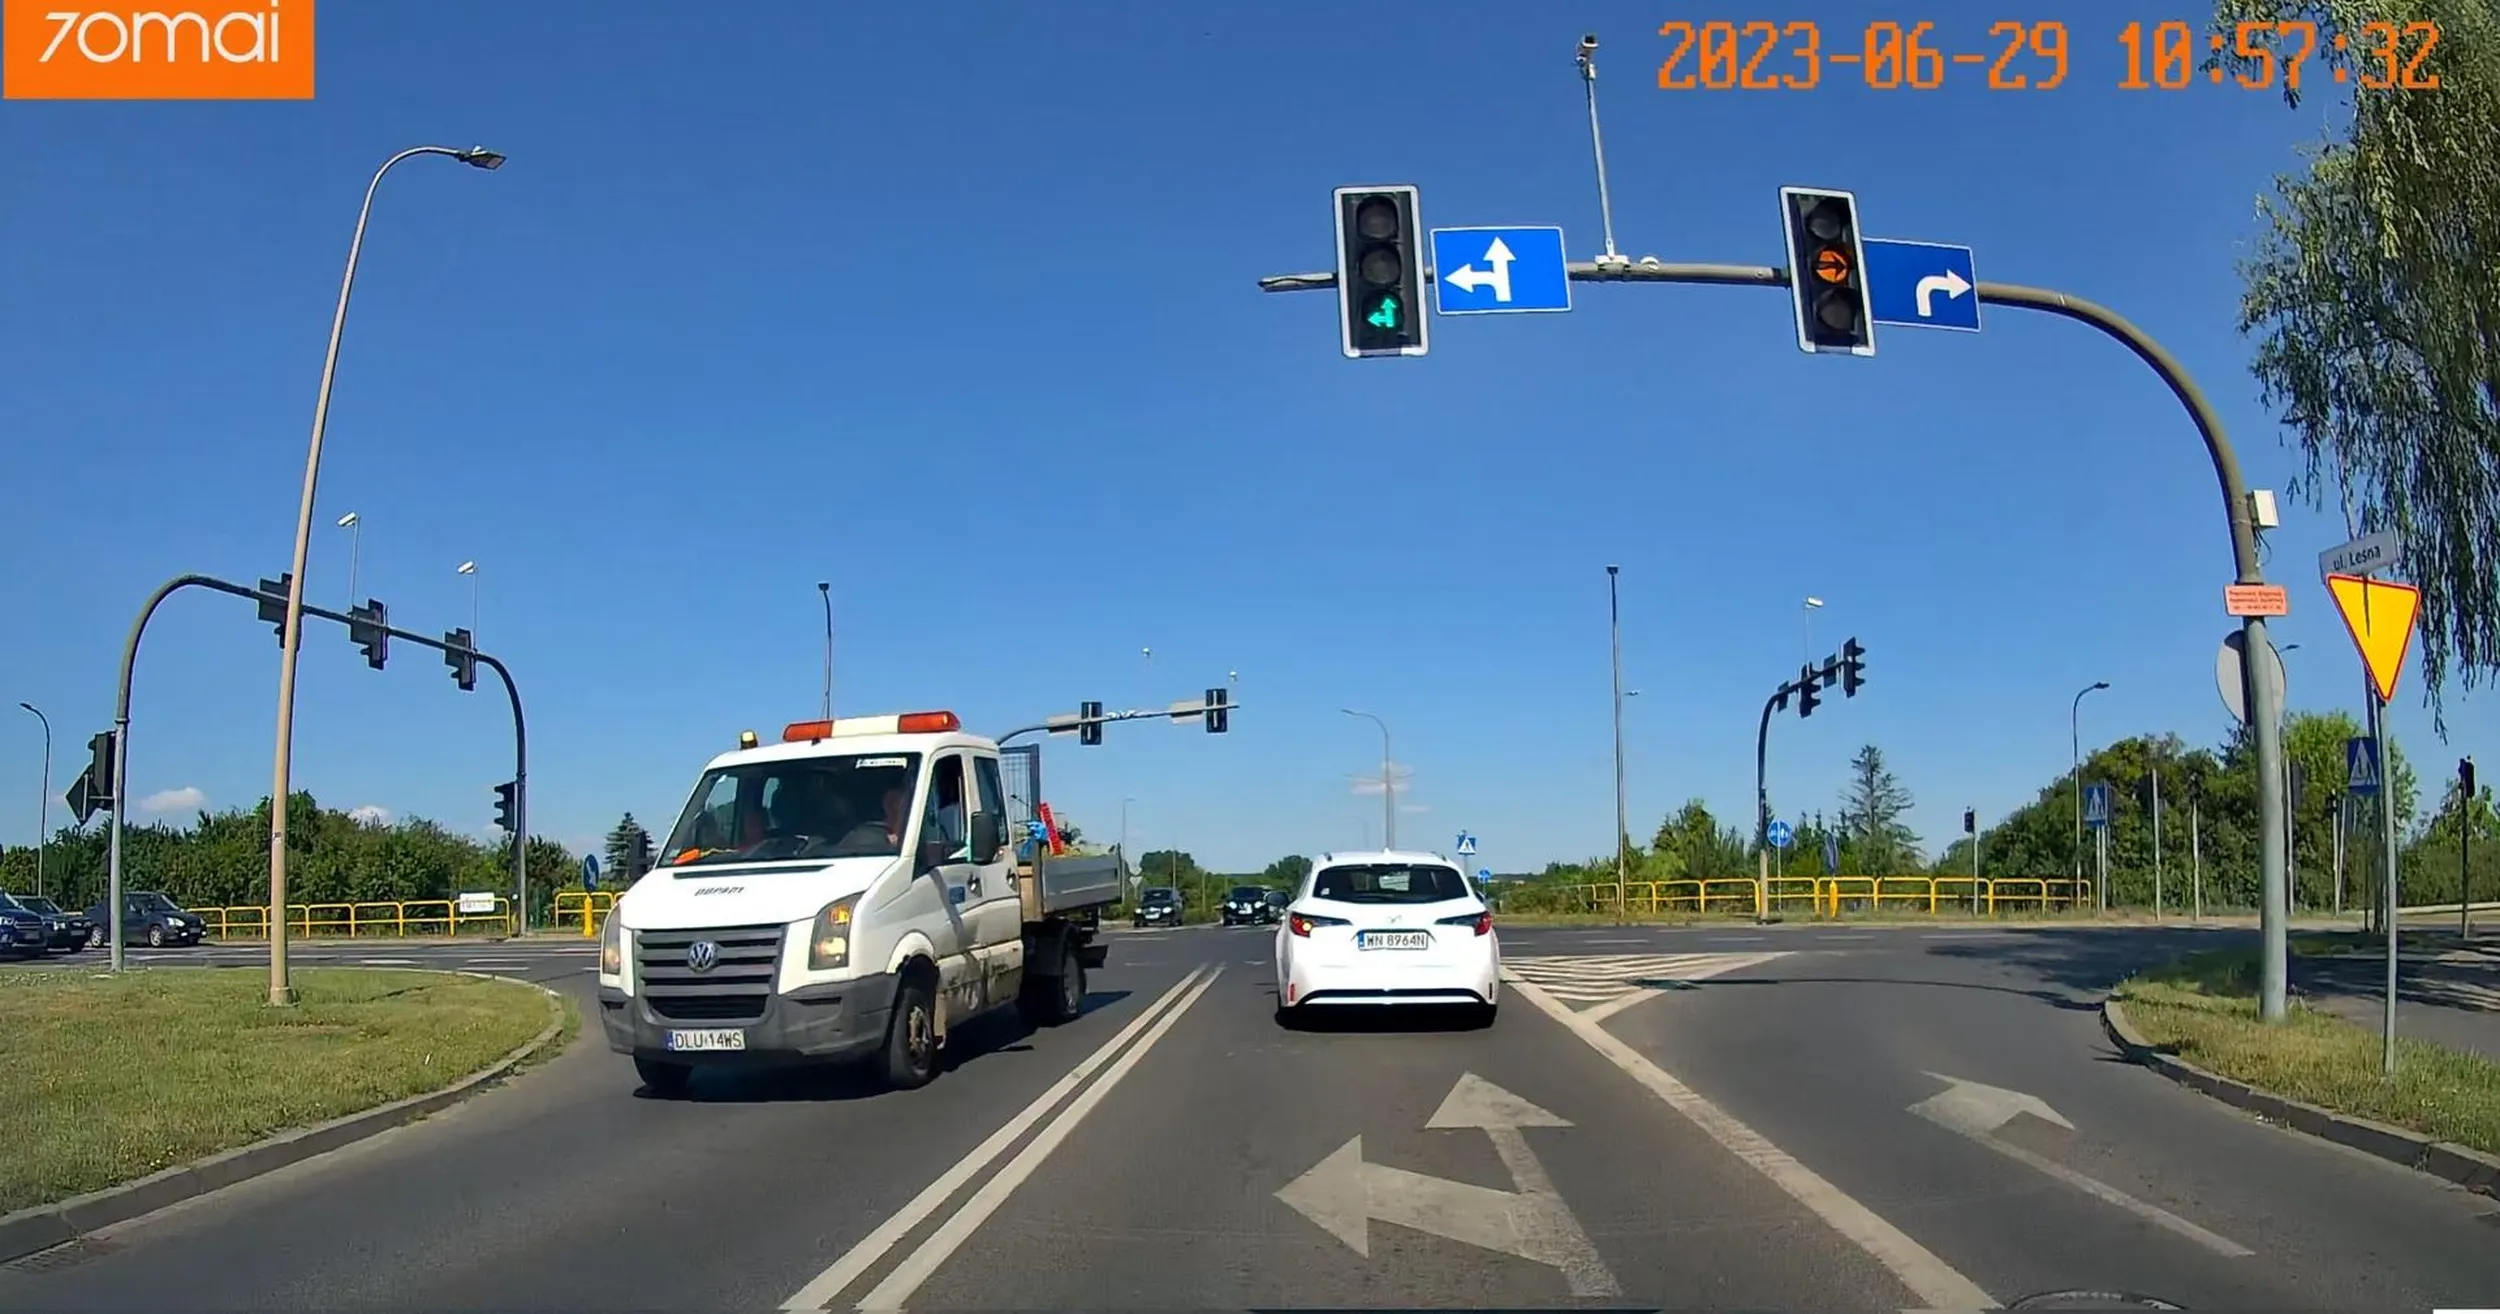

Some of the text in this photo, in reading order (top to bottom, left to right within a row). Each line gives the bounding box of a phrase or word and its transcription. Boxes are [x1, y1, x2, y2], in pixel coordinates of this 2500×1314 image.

[2333, 554, 2347, 571] ul.
[1367, 934, 1425, 946] WN 8964N
[675, 1032, 703, 1048] DLU
